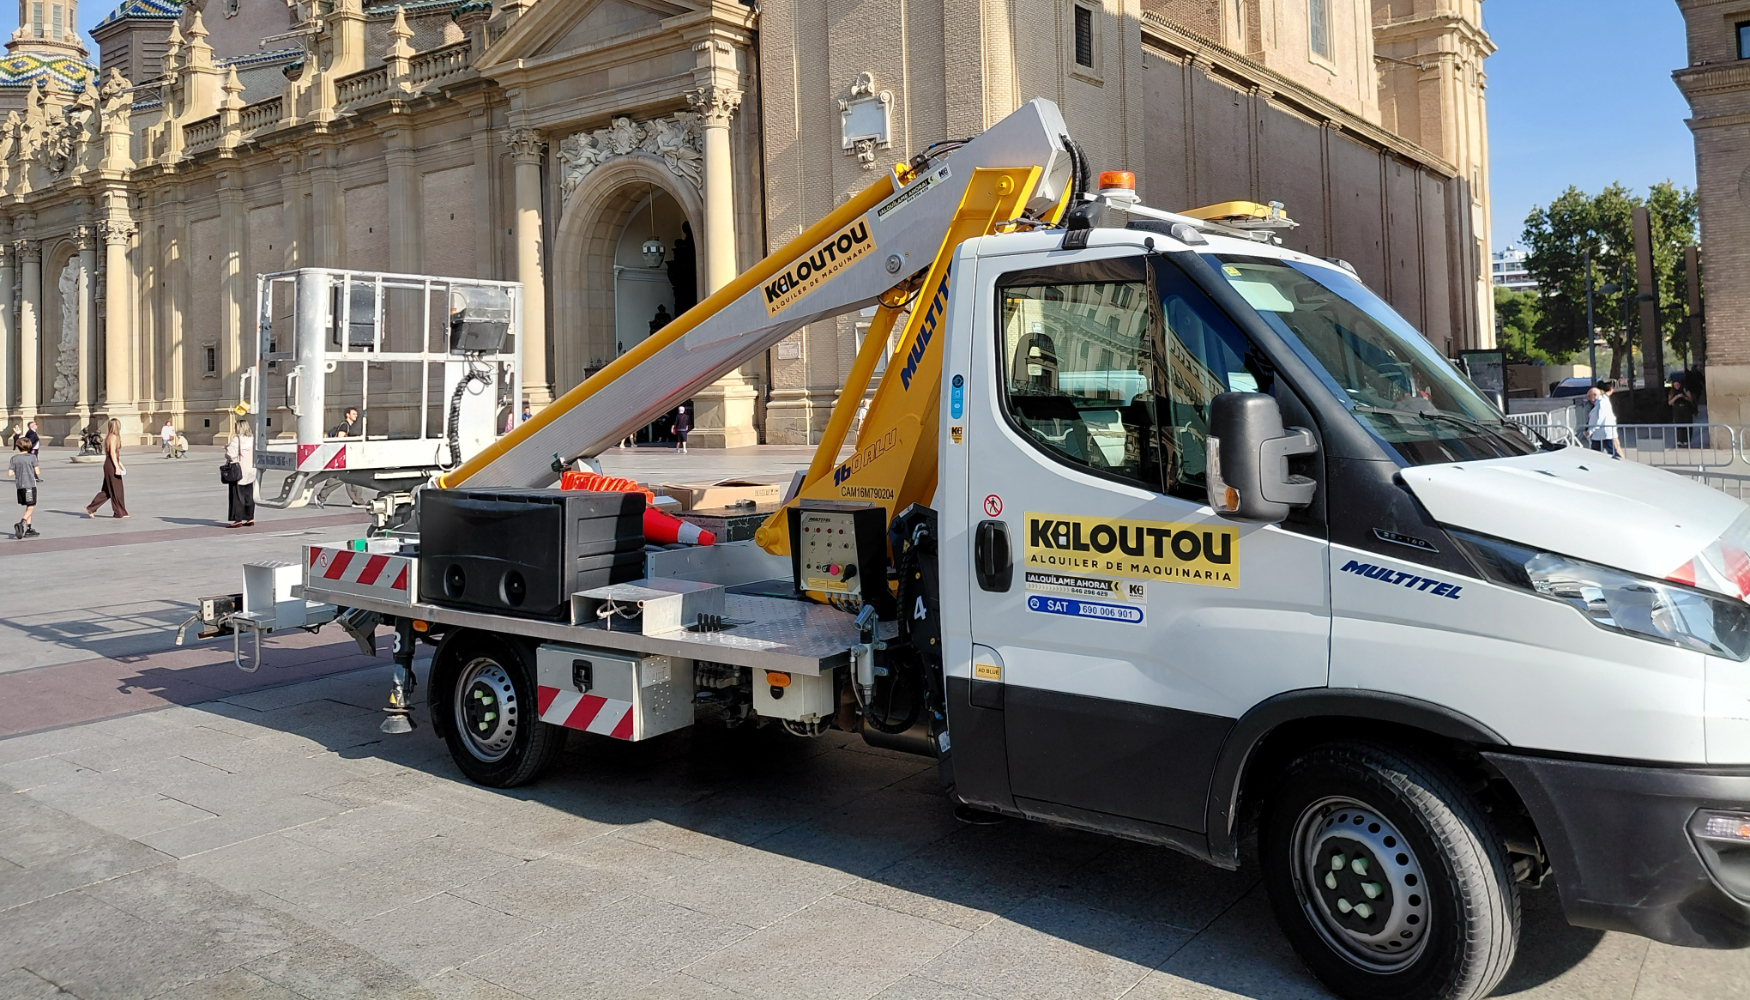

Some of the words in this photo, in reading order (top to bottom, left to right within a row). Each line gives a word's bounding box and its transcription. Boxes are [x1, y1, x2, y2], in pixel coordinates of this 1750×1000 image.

[771, 286, 807, 313] ALQUILER
[809, 278, 819, 288] DE
[821, 243, 872, 279] MAQUINARIA
[900, 258, 953, 392] MULTIT
[841, 486, 894, 500] CAM16M790204
[1031, 554, 1098, 569] ALQUILER
[1106, 561, 1123, 571] DE
[1130, 564, 1231, 582] MAQUINARIA
[1340, 560, 1463, 600] MULTITEL
[1076, 580, 1108, 590] AHORA!
[914, 595, 927, 621] 4
[1047, 600, 1068, 612] SAT
[1082, 605, 1098, 615] 690
[1100, 606, 1115, 617] 006
[1117, 609, 1133, 619] 901
[393, 631, 401, 653] 3
